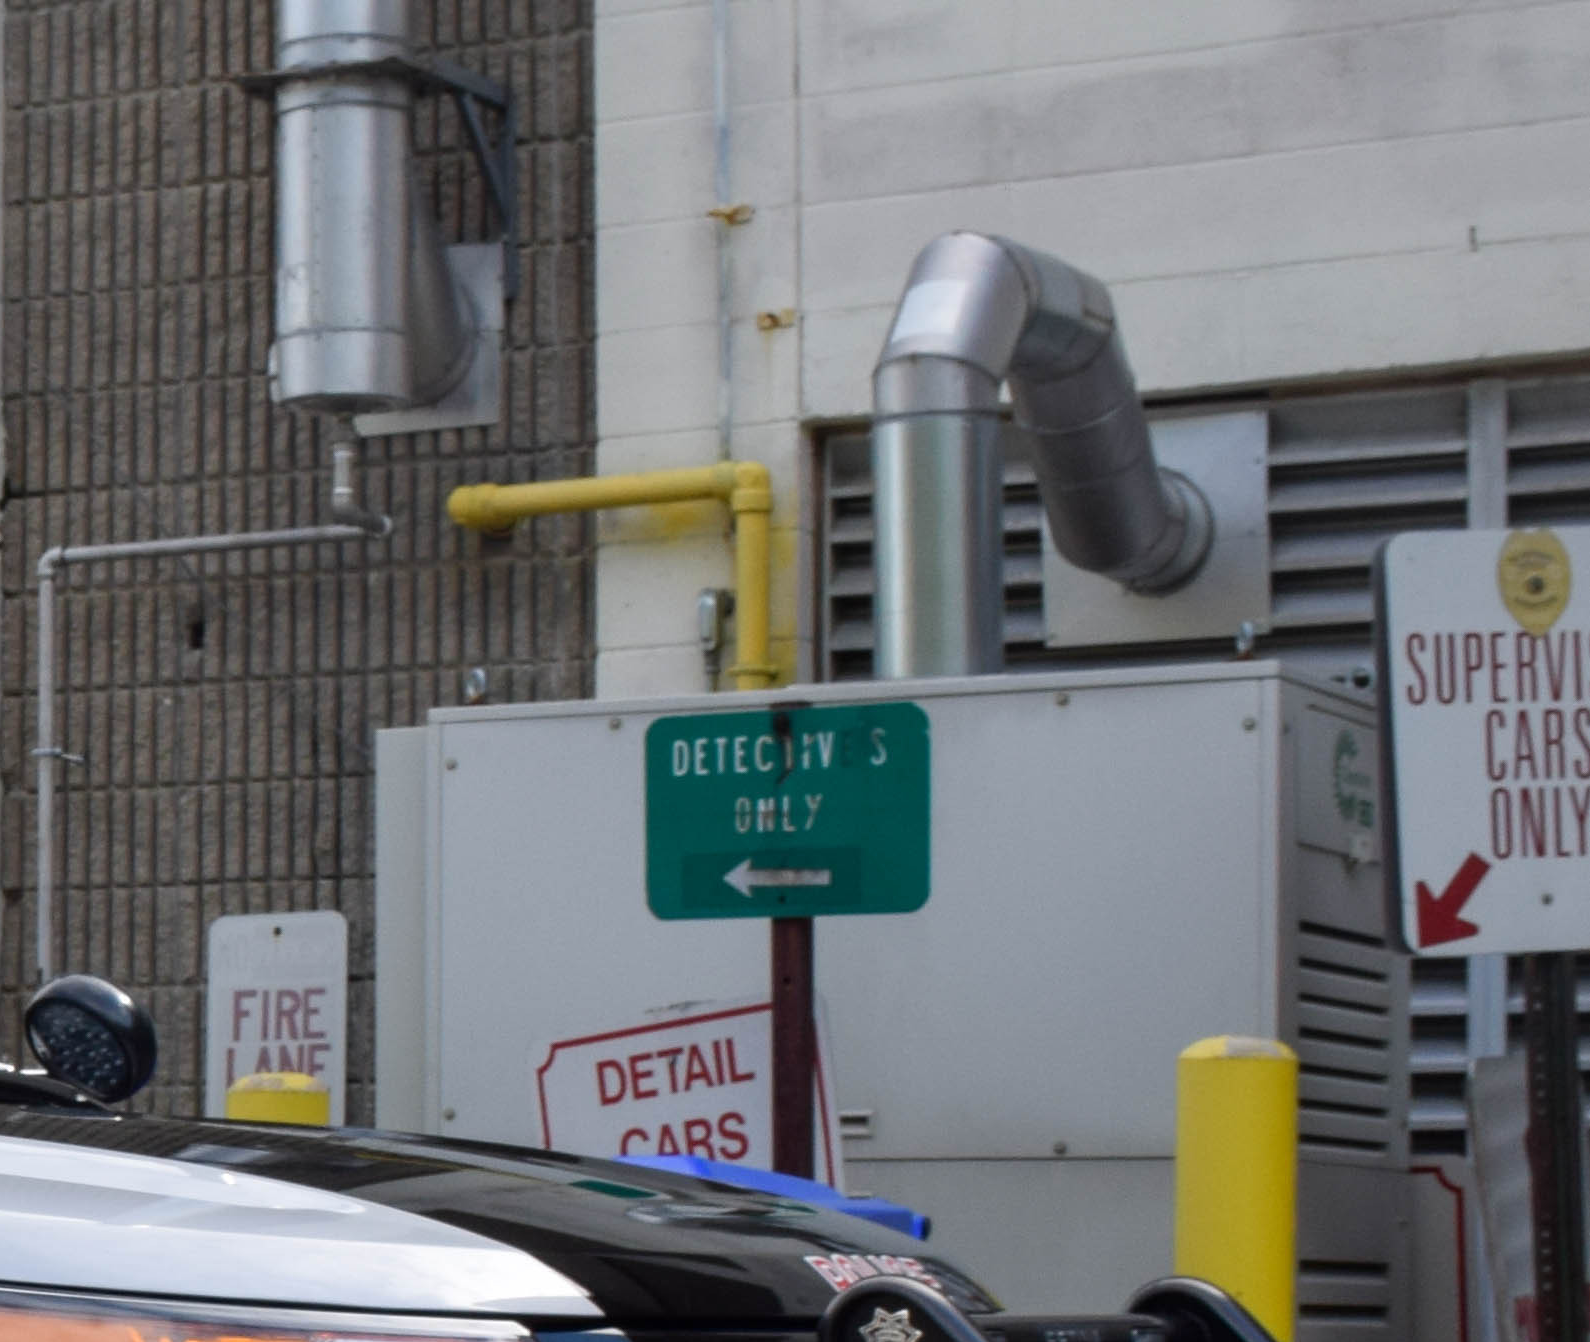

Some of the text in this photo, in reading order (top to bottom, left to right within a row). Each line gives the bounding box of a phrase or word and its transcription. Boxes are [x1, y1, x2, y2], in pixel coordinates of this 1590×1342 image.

[1406, 631, 1590, 706] SUPERVI
[1485, 708, 1590, 782] CARS
[735, 793, 822, 834] ONLY
[233, 986, 327, 1042] FIRE
[595, 1037, 756, 1107] DETAIL
[620, 1111, 750, 1162] CARS
